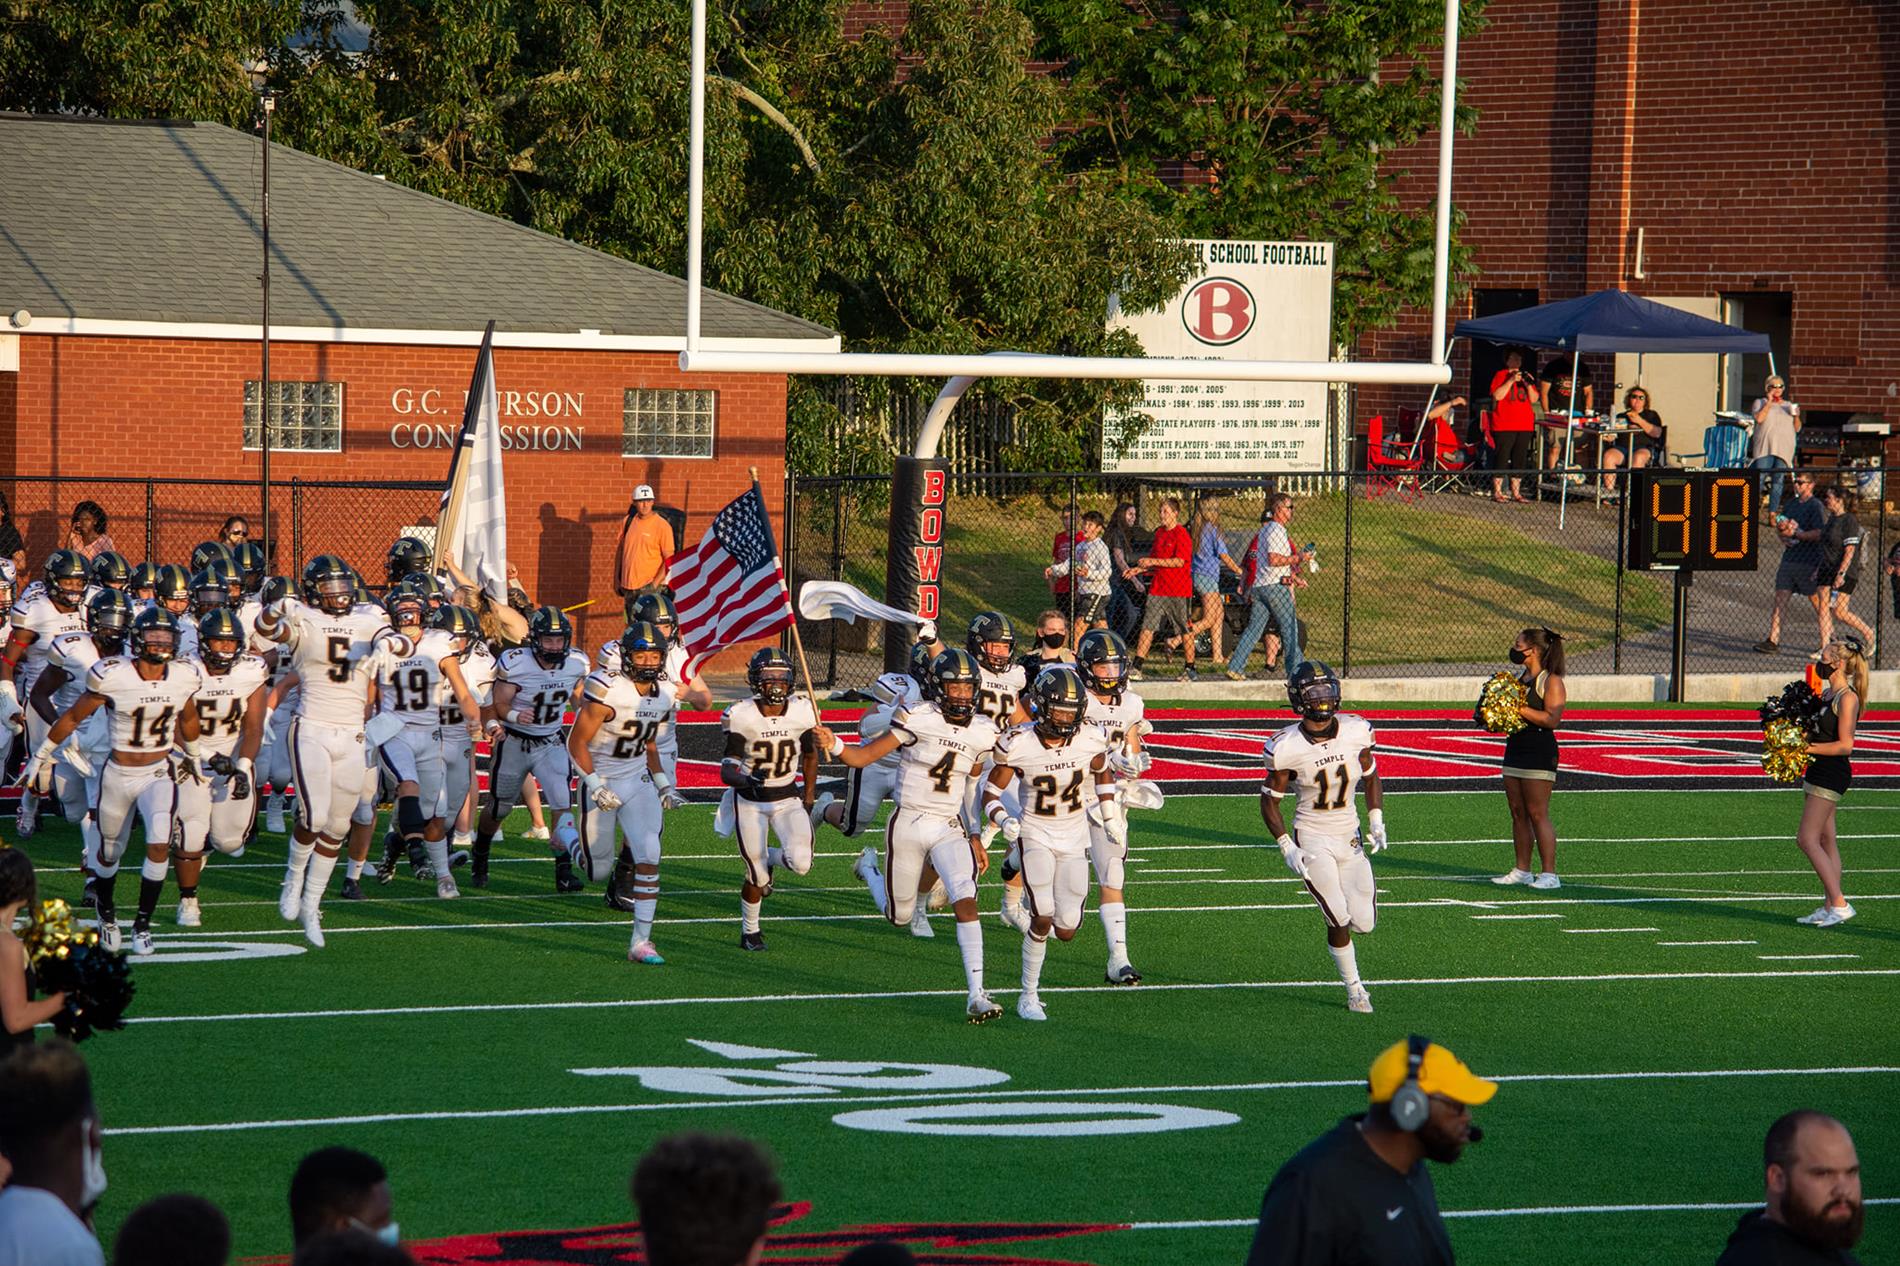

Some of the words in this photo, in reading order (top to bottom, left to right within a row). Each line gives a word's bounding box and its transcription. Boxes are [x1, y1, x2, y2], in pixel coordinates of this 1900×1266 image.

[1210, 243, 1258, 265] SCHOOL
[1262, 245, 1327, 266] FOOTBALL
[1192, 281, 1250, 341] B
[391, 388, 448, 414] G.C.
[1288, 400, 1304, 409] 2013
[1155, 420, 1178, 428] STATE
[1180, 420, 1216, 428] PLAYOFFS
[390, 423, 584, 451] CONSSION
[1141, 441, 1150, 449] OF
[1151, 441, 1173, 449] STATE
[1174, 441, 1209, 449] PLAYOFFS
[641, 489, 650, 497] T
[1652, 478, 1750, 559] 40
[322, 626, 354, 635] TEMPLE
[327, 636, 351, 683] 5
[394, 659, 423, 669] TEMPLE
[388, 668, 430, 712] 19
[540, 682, 565, 691] TEMPLE
[986, 681, 1009, 691] TEMPLE
[206, 689, 235, 697] TEMPLE
[140, 696, 171, 704] TEMPLE
[531, 689, 570, 725] 12
[195, 698, 243, 736] 54
[635, 710, 658, 719] TEMPLE
[128, 705, 175, 748] 14
[952, 727, 959, 735] T
[1098, 720, 1123, 729] TEMPLE
[761, 730, 789, 739] TEMPLE
[938, 738, 967, 753] TEMPLE
[750, 739, 797, 780] 20
[1055, 749, 1062, 757] T
[1044, 761, 1076, 773] TEMPLE
[1314, 754, 1345, 768] TEMPLE
[928, 750, 958, 794] 4
[1032, 768, 1085, 818] 24
[1313, 762, 1351, 811] 11
